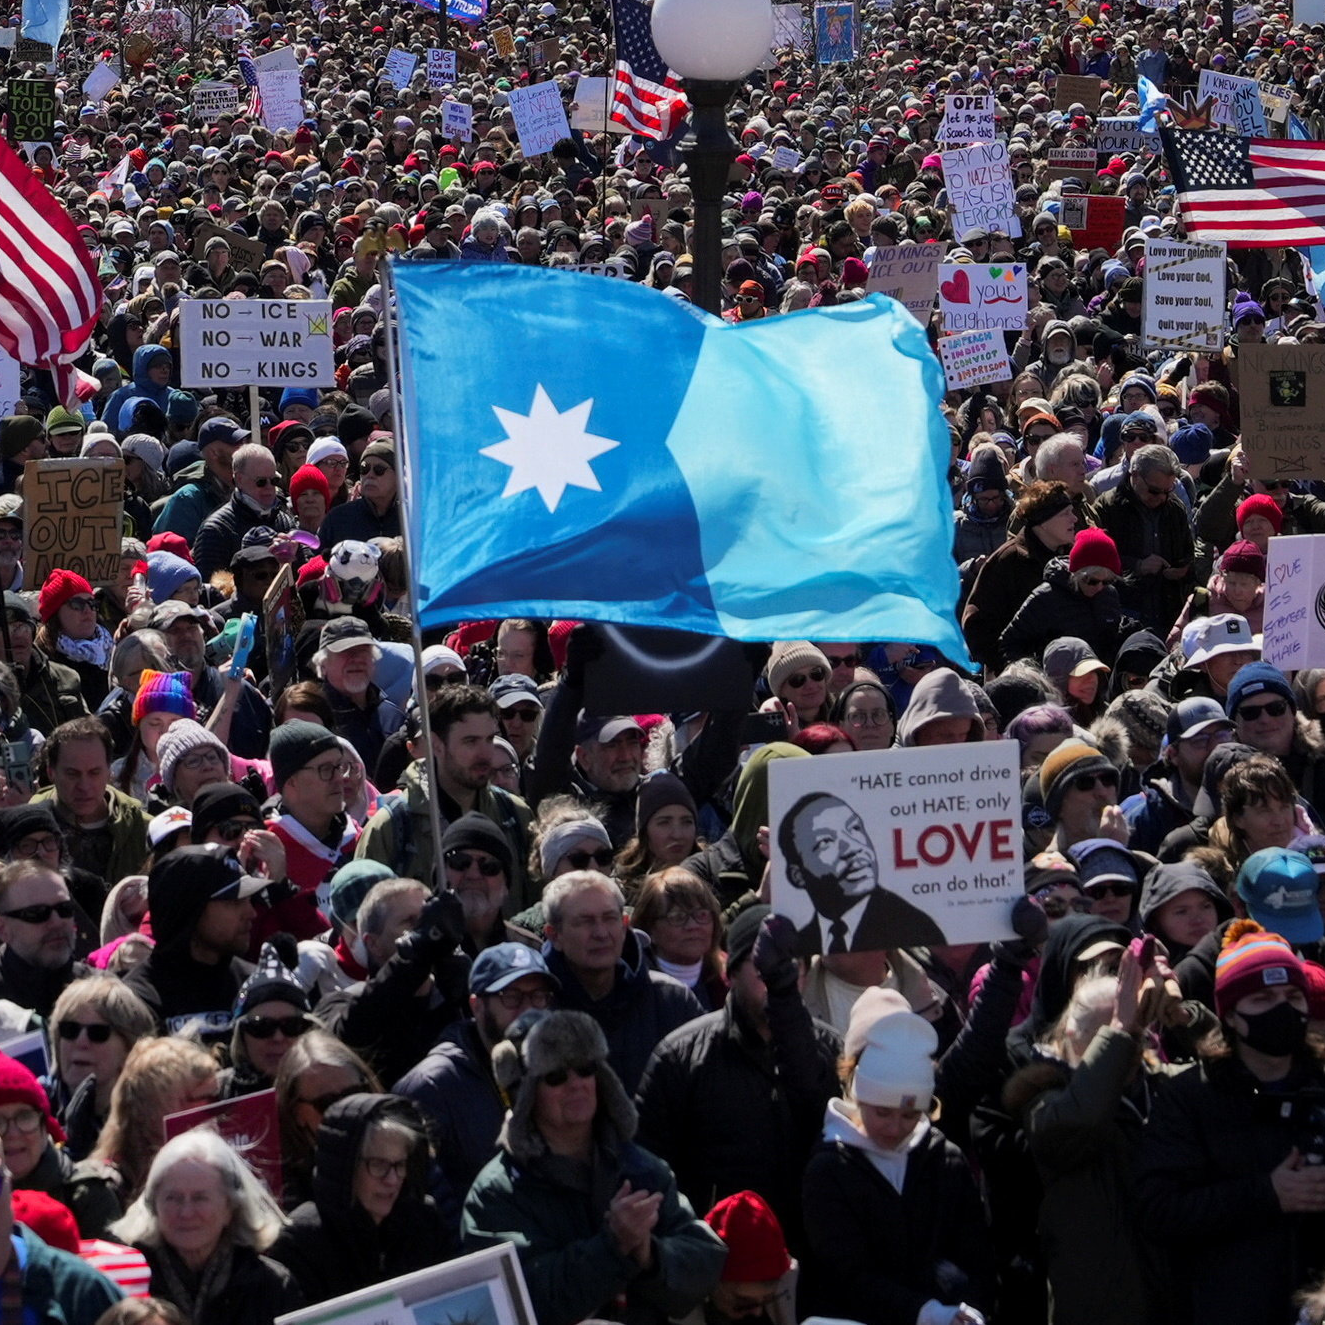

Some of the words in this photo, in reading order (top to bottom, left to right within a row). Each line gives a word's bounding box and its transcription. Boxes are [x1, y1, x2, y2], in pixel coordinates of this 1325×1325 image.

[432, 51, 451, 63] BIG
[13, 82, 49, 96] WE
[9, 96, 54, 112] TOLD
[953, 97, 989, 111] OPE!
[12, 112, 51, 127] YOU
[14, 126, 45, 140] SO
[942, 154, 972, 170] SAY
[983, 147, 1004, 163] NO
[947, 173, 963, 189] TO
[967, 166, 1011, 187] NAZISM
[951, 183, 1015, 207] FASCISM
[1149, 246, 1167, 257] Love
[1168, 248, 1186, 259] your
[1187, 245, 1223, 260] neighbor
[1157, 271, 1173, 283] Love
[1175, 273, 1193, 283] your
[1195, 272, 1213, 284] God,
[975, 283, 1017, 309] your
[1155, 296, 1172, 307] Save
[1174, 297, 1192, 308] your
[1195, 296, 1213, 309] Soul,
[203, 303, 231, 319] NO
[262, 303, 297, 319] ICE
[944, 311, 1023, 331] neighbors
[203, 331, 231, 348] NO
[260, 331, 303, 348] WAR
[949, 332, 993, 349] IMPEACH
[952, 343, 986, 360] INDICT
[954, 351, 998, 370] CONVICT
[201, 363, 231, 379] NO
[259, 362, 318, 378] KINGS
[958, 361, 1007, 381] IMPRISON
[36, 468, 123, 514] ICE
[29, 516, 116, 552] OUT
[907, 771, 965, 789] cannot
[969, 765, 1011, 781] drive
[890, 801, 919, 817] out
[923, 797, 971, 815] HATE;
[975, 793, 1011, 814] only
[893, 819, 1015, 870] LOVE
[911, 879, 941, 895] can
[947, 877, 968, 893] do
